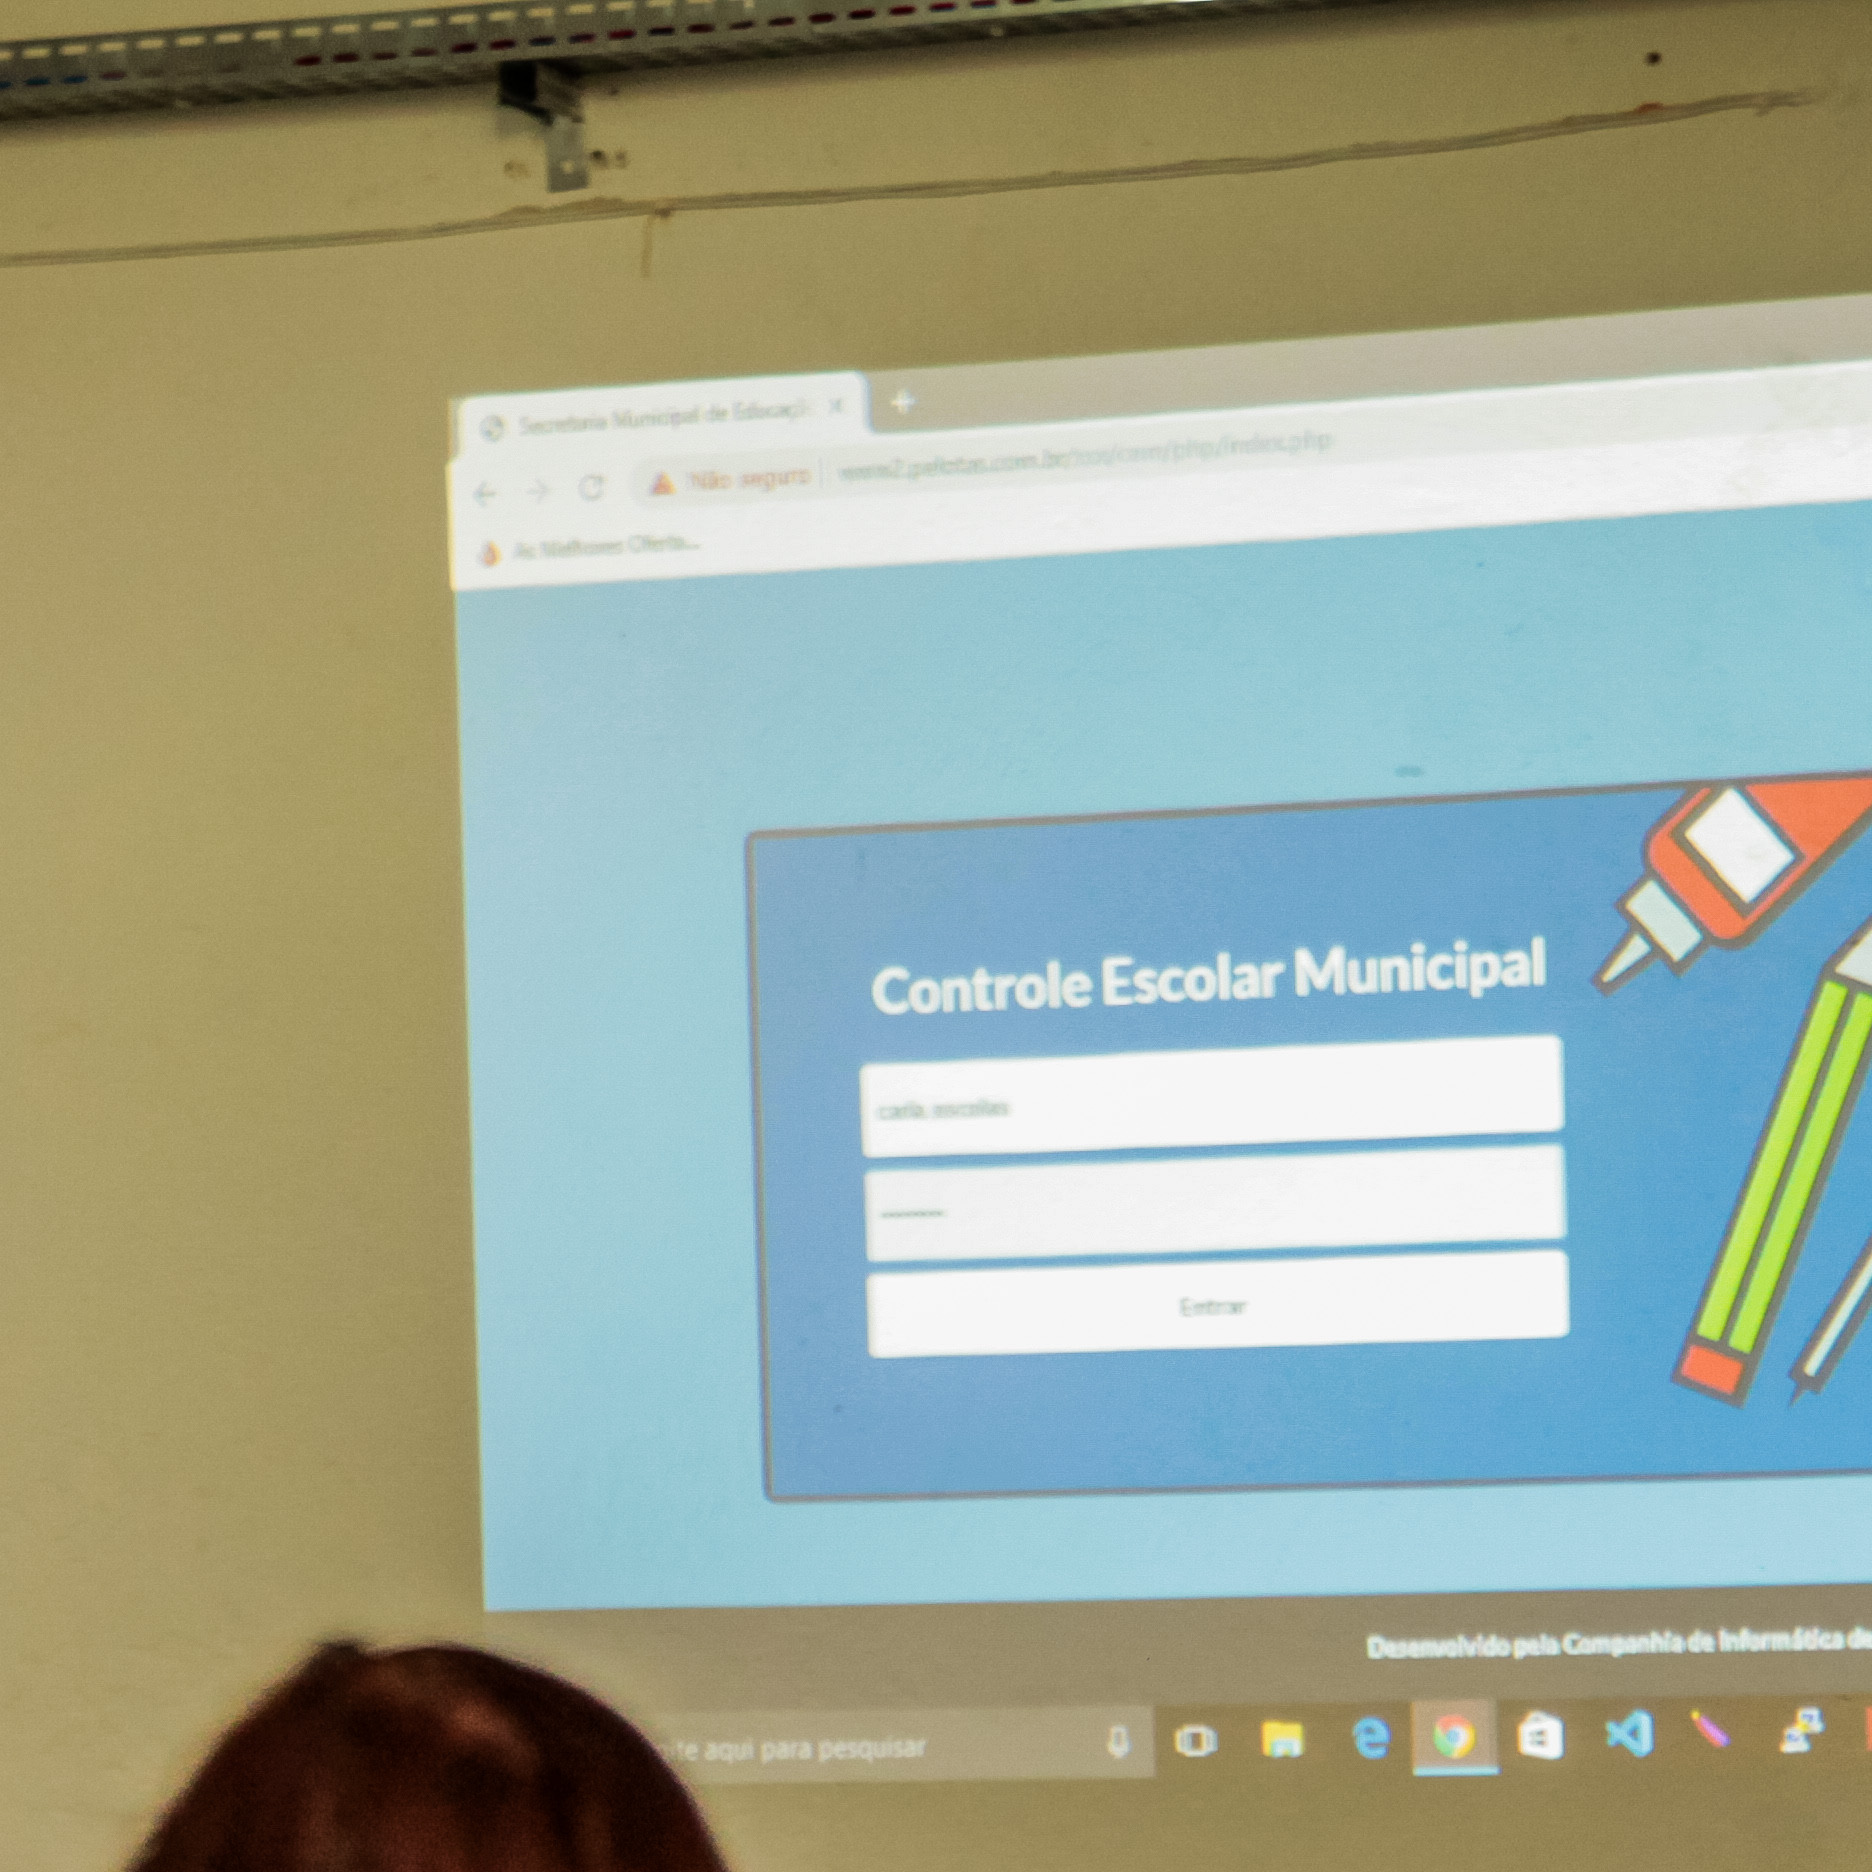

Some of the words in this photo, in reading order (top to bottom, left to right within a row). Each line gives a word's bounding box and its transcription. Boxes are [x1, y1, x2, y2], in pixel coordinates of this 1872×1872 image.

[611, 408, 699, 432] Municipal
[703, 404, 728, 424] de
[687, 468, 732, 490] Não
[739, 468, 812, 493] seguro
[872, 960, 1092, 1015] Controle
[1101, 951, 1286, 1007] Escolar
[1294, 936, 1548, 999] Municipal
[1180, 1296, 1248, 1318] Entrar
[1367, 1633, 1510, 1659] Desenvolvido
[1513, 1633, 1560, 1661] pela
[1562, 1631, 1684, 1660] Companhia
[1687, 1629, 1716, 1654] de
[1719, 1627, 1845, 1653] Informática
[704, 1737, 755, 1765] aqui
[760, 1737, 812, 1765] para
[818, 1734, 926, 1763] pesquisar
